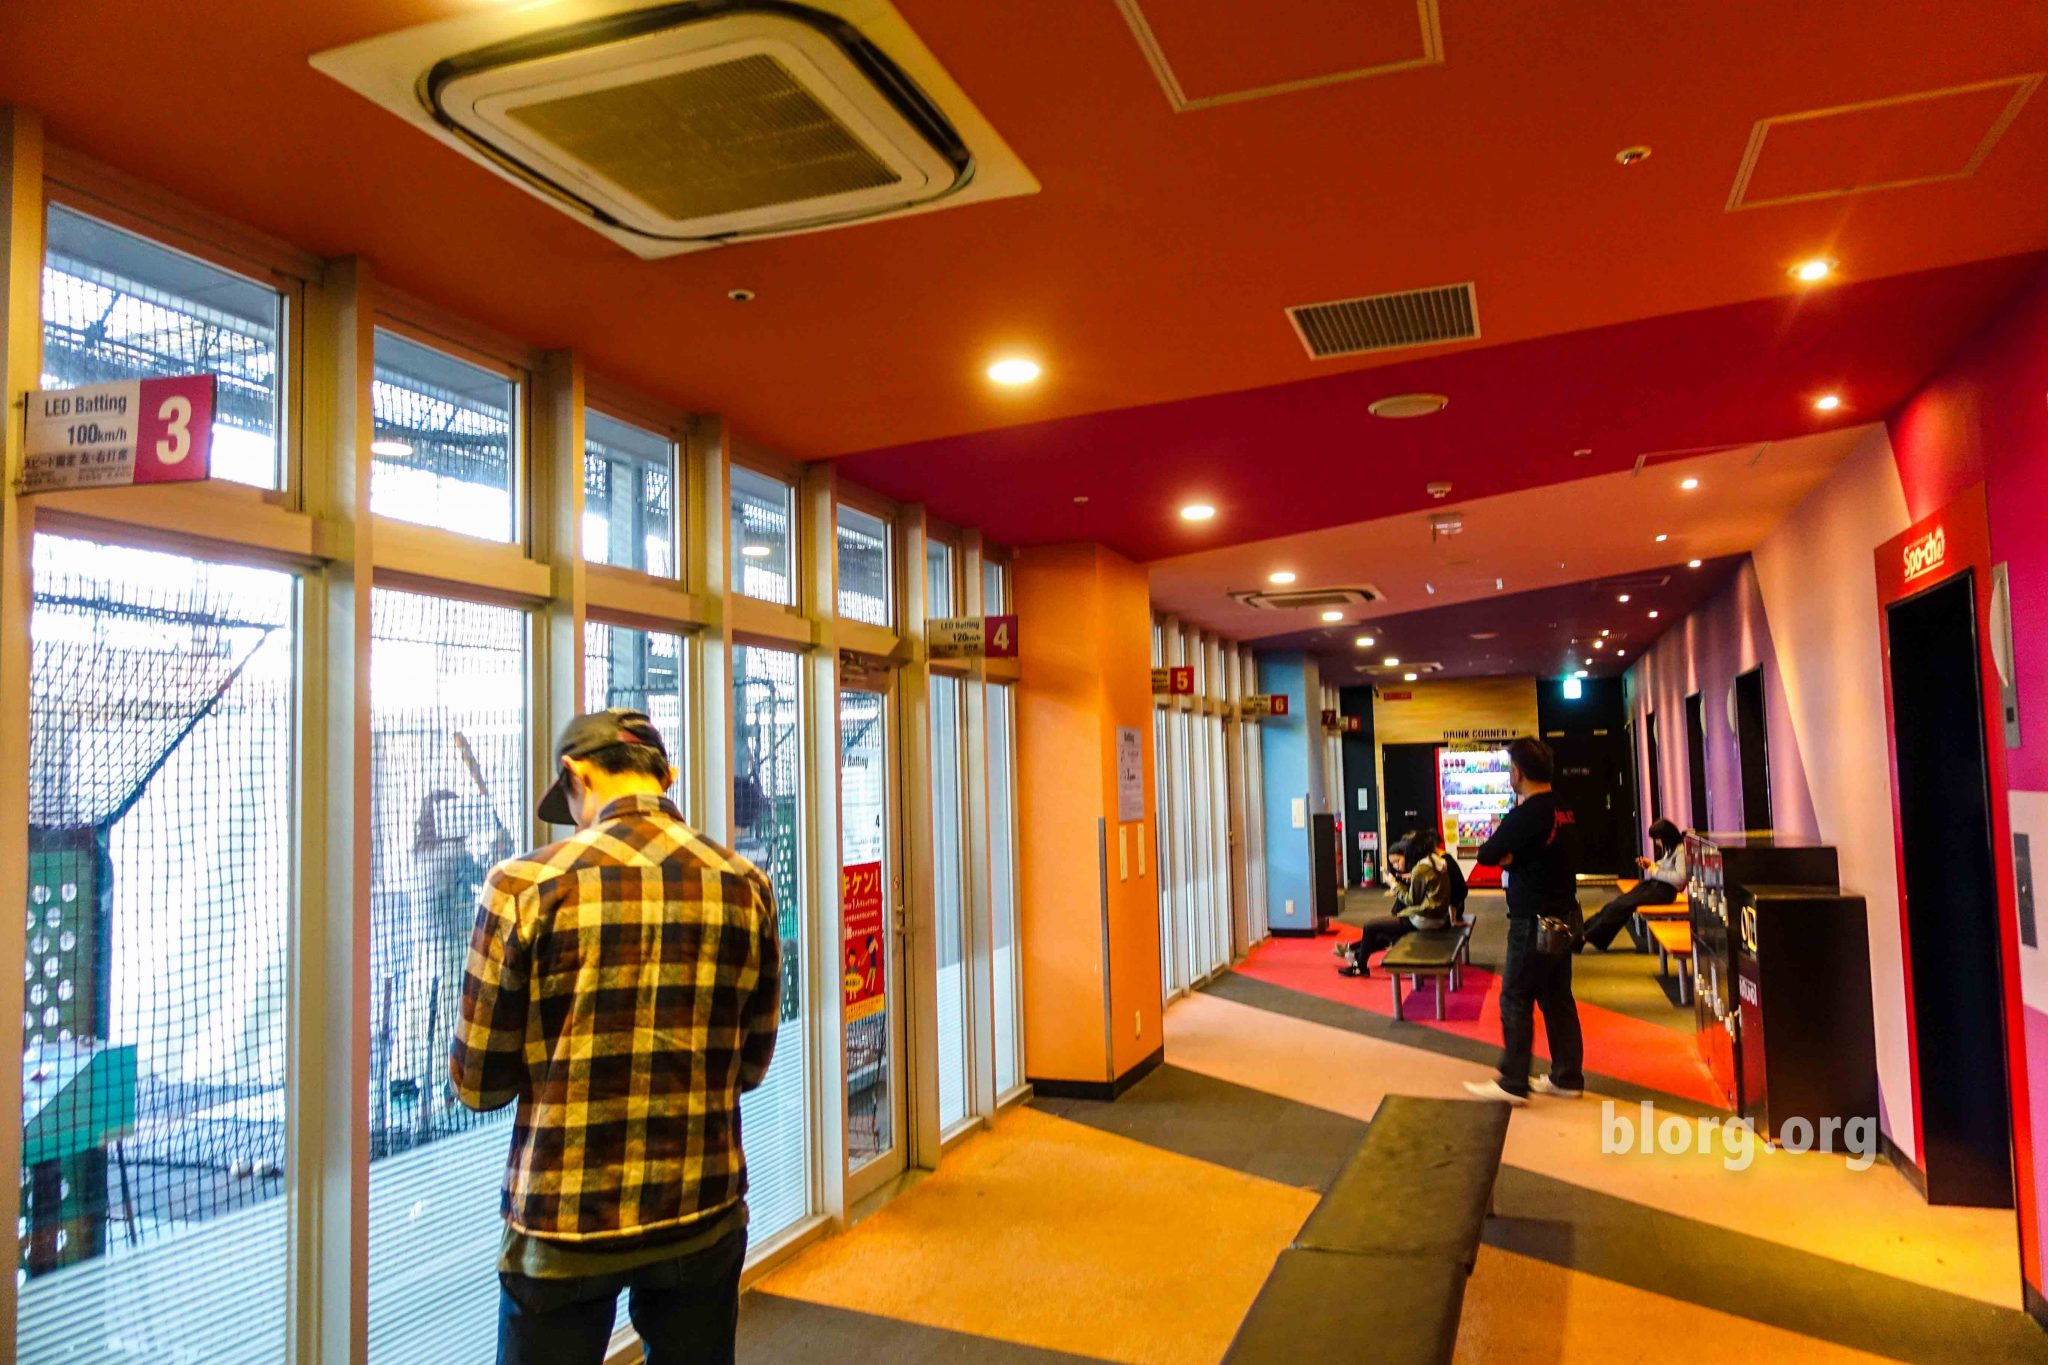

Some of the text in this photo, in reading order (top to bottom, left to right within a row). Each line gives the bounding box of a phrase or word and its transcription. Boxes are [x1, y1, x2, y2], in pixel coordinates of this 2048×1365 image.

[45, 393, 127, 417] LED Batting
[67, 422, 127, 446] 100km/h
[155, 395, 192, 465] 3
[992, 622, 1010, 651] 4
[1176, 671, 1189, 690] 5
[1275, 697, 1284, 712] 6
[1325, 712, 1334, 723] 7
[1443, 728, 1508, 739] DRINK CORNER
[847, 754, 869, 770] Batting
[875, 813, 880, 829] 4
